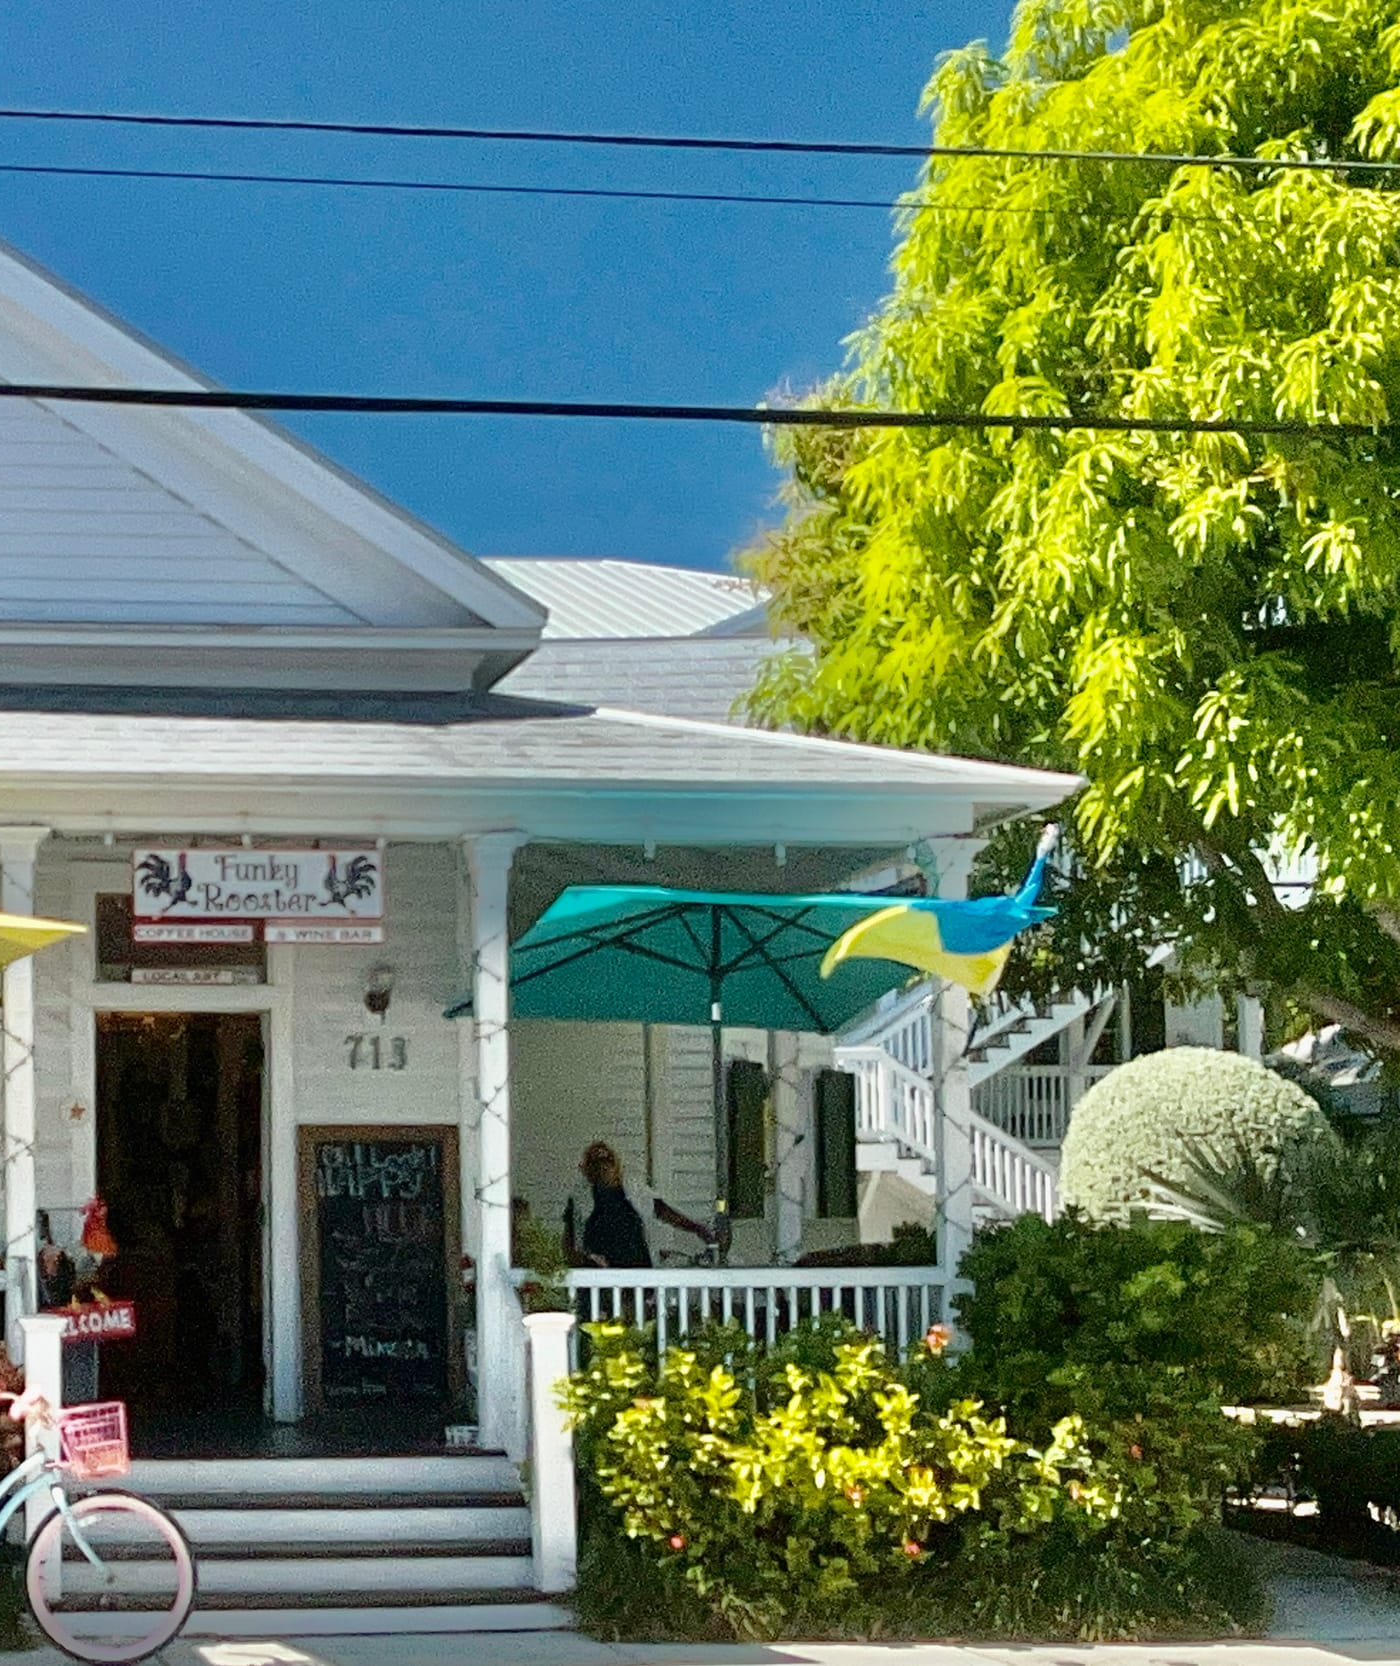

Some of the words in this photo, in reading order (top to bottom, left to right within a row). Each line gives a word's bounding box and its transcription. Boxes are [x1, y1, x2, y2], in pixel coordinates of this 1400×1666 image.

[214, 855, 299, 889] Funky
[198, 883, 318, 913] Rooster
[136, 926, 196, 940] COFFEE
[201, 926, 250, 940] HOUSE
[295, 929, 336, 941] WINE
[340, 929, 373, 941] BAR
[344, 1035, 408, 1070] 713
[61, 1308, 133, 1338] LCOME
